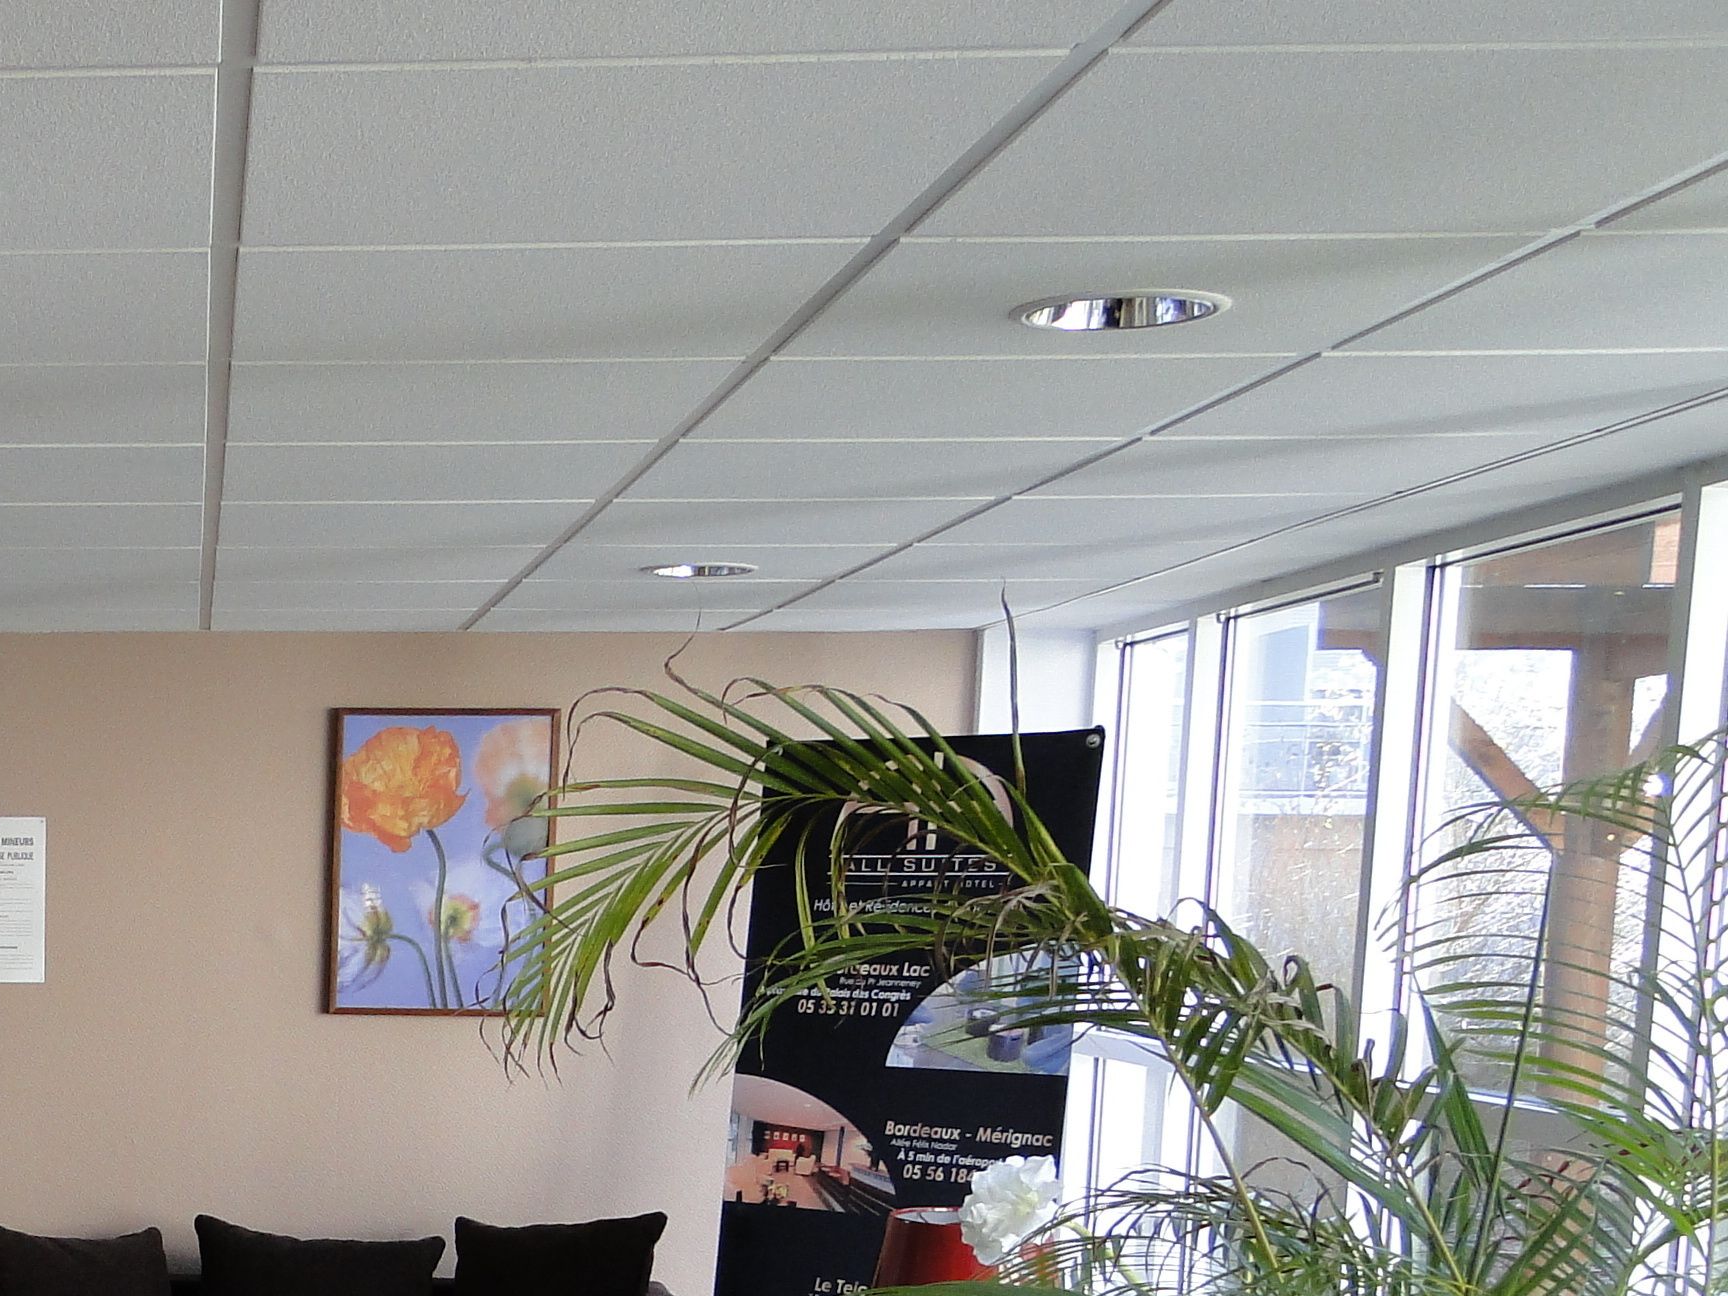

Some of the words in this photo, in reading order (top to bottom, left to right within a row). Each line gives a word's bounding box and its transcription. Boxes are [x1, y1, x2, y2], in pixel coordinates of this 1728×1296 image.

[1, 837, 34, 846] MINEURS
[903, 858, 997, 873] SUTES
[901, 880, 950, 889] APPAT
[959, 881, 995, 889] OTEL
[902, 962, 931, 977] Lac
[839, 976, 855, 985] Rue
[871, 989, 912, 1002] Congrès
[797, 998, 815, 1014] 05
[860, 1002, 878, 1017] 01
[882, 1002, 900, 1017] 01
[884, 1120, 962, 1141] Bordeaux
[975, 1126, 1054, 1149] Mérignac
[890, 1138, 911, 1148] Allée
[931, 1141, 959, 1151] Nadar
[897, 1147, 906, 1160] À
[907, 1150, 916, 1161] 5
[916, 1151, 935, 1163] min
[936, 1153, 951, 1164] de
[903, 1163, 923, 1179] 05
[925, 1166, 945, 1181] 56
[814, 1277, 832, 1292] Le
